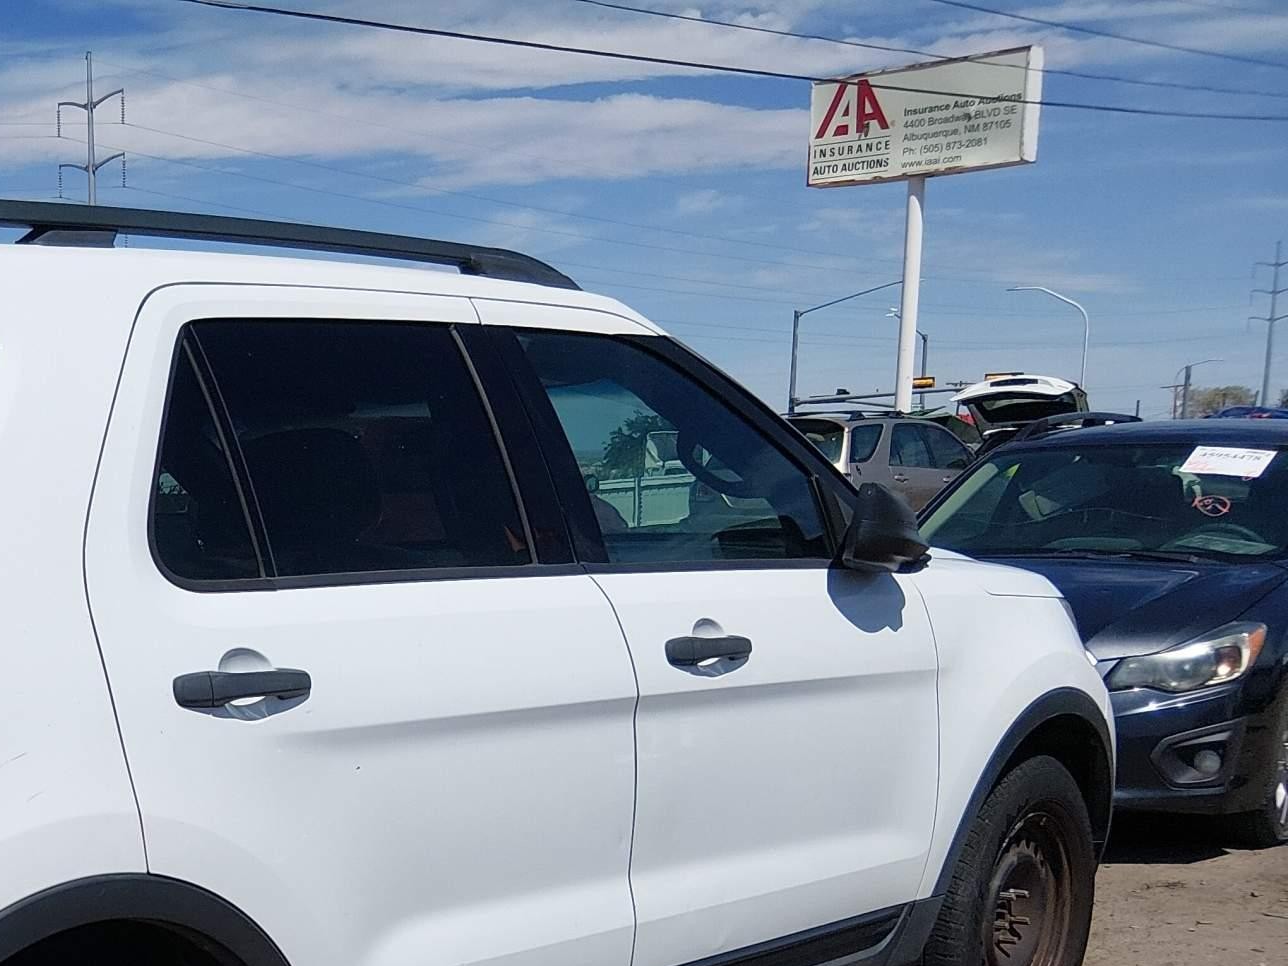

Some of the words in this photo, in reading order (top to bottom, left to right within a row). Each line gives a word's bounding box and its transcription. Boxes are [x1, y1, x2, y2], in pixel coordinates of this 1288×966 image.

[903, 102, 950, 117] Insurance
[953, 99, 976, 109] Auto
[903, 118, 926, 129] 4400
[927, 112, 972, 127] Broadway
[974, 107, 1001, 120] BLVD
[1003, 104, 1018, 116] SE
[902, 127, 962, 143] Albuquerque,
[963, 123, 981, 135] NM
[982, 119, 1012, 132] 87105
[813, 140, 891, 160] INSURANCE
[919, 142, 944, 156] (505)
[945, 137, 988, 151] 873-2081
[812, 163, 839, 177] AUTO
[840, 158, 889, 173] AUCTIONS
[900, 155, 963, 168] www.iaai.com
